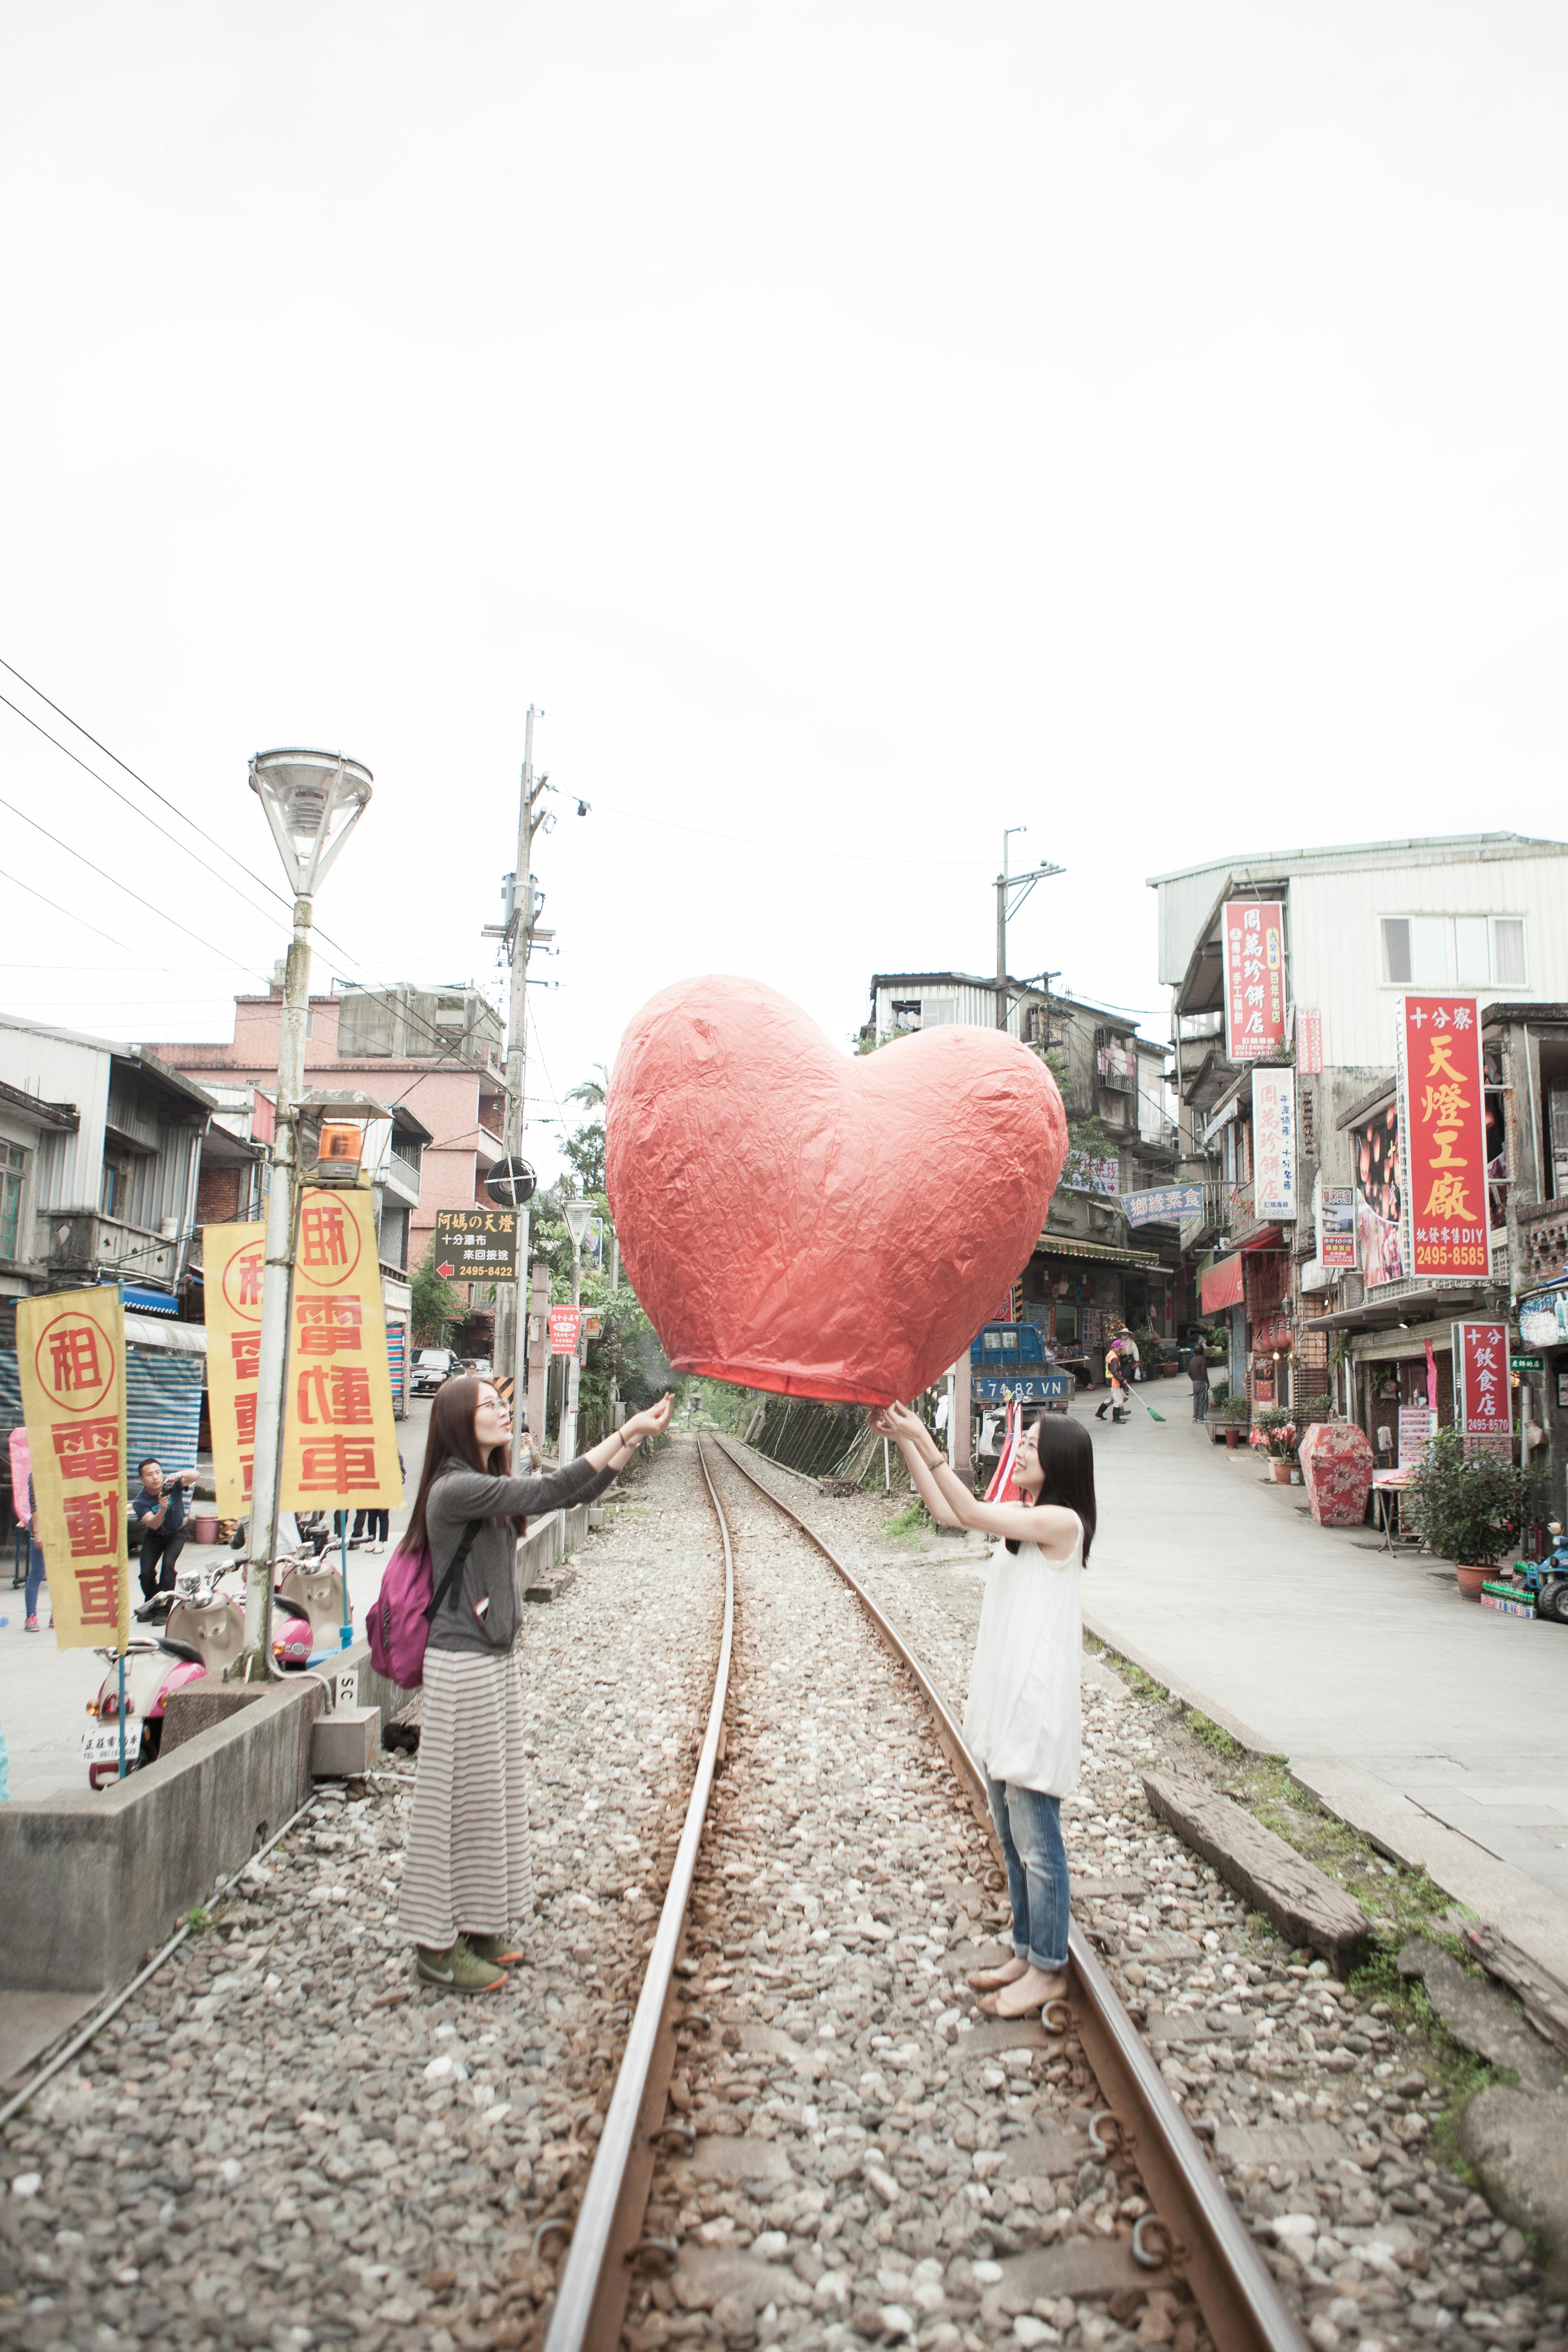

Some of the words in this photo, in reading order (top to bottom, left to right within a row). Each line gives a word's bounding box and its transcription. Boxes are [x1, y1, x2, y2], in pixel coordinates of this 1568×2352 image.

[1270, 972, 1281, 1024] 百年老店
[1409, 1006, 1473, 1030] 十分寮
[1421, 1034, 1478, 1221] 天燈工廠
[1259, 1085, 1282, 1200] 周萬珍餅店
[1130, 1188, 1201, 1217] 鄉緣素食
[438, 1212, 515, 1232] 阿媽の天燈
[441, 1234, 487, 1246] 十分瀑布
[463, 1249, 509, 1261] 來回接送
[1417, 1246, 1485, 1266] 2495-8585
[460, 1265, 513, 1277] 2495-8422
[1466, 1328, 1503, 1346] 十分
[49, 1326, 103, 1392] 租
[1512, 1359, 1540, 1368] 老師的店
[1473, 1347, 1498, 1416] 飲食店
[1468, 1418, 1508, 1431] 2495-8570
[51, 1415, 119, 1628] 電動車
[100, 1748, 137, 1758] 09119529
